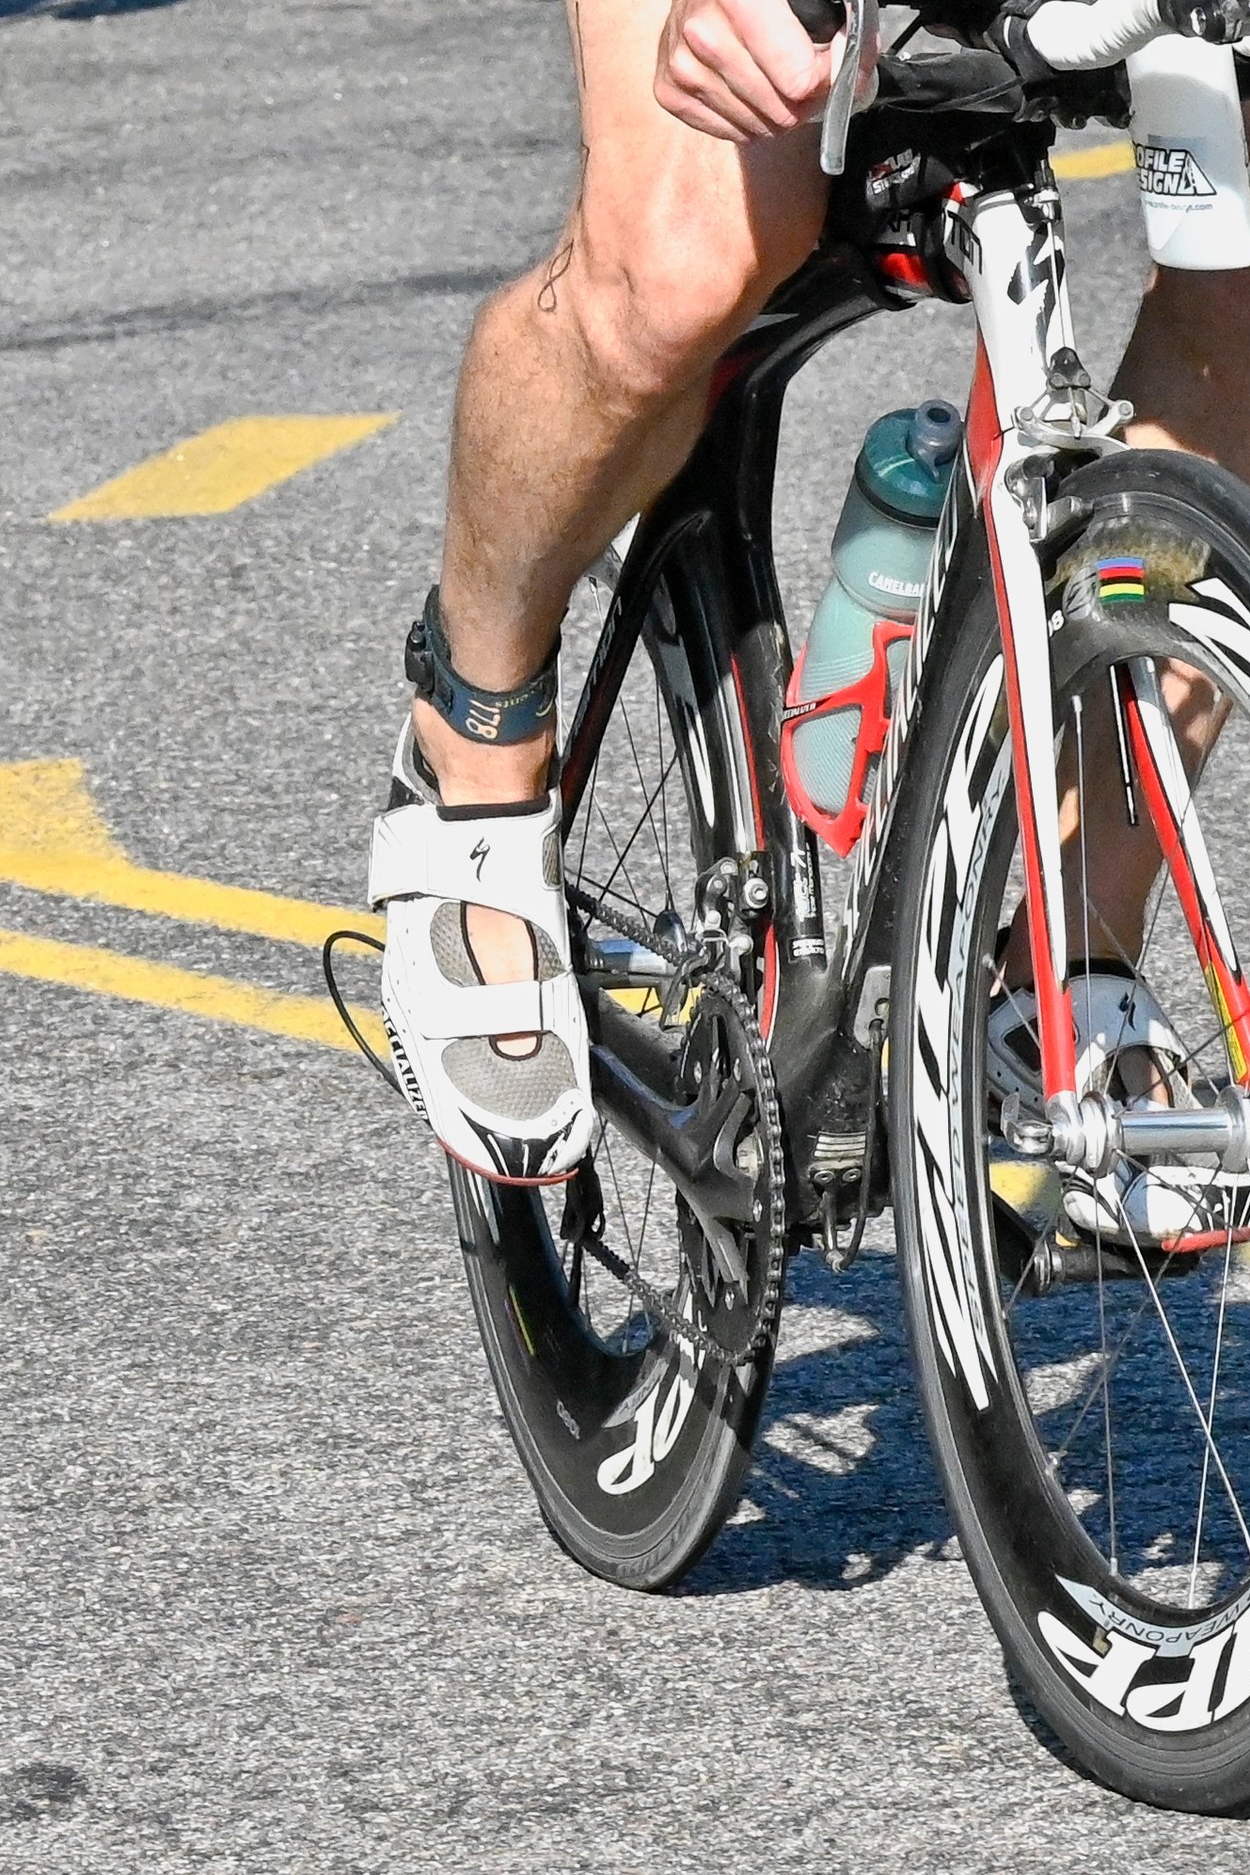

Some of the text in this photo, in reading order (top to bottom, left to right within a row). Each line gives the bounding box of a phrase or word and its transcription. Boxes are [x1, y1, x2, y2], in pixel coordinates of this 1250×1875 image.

[1136, 145, 1187, 174] OFILE
[1139, 169, 1181, 194] SIGN
[1089, 1593, 1241, 1644] WEAPONRY
